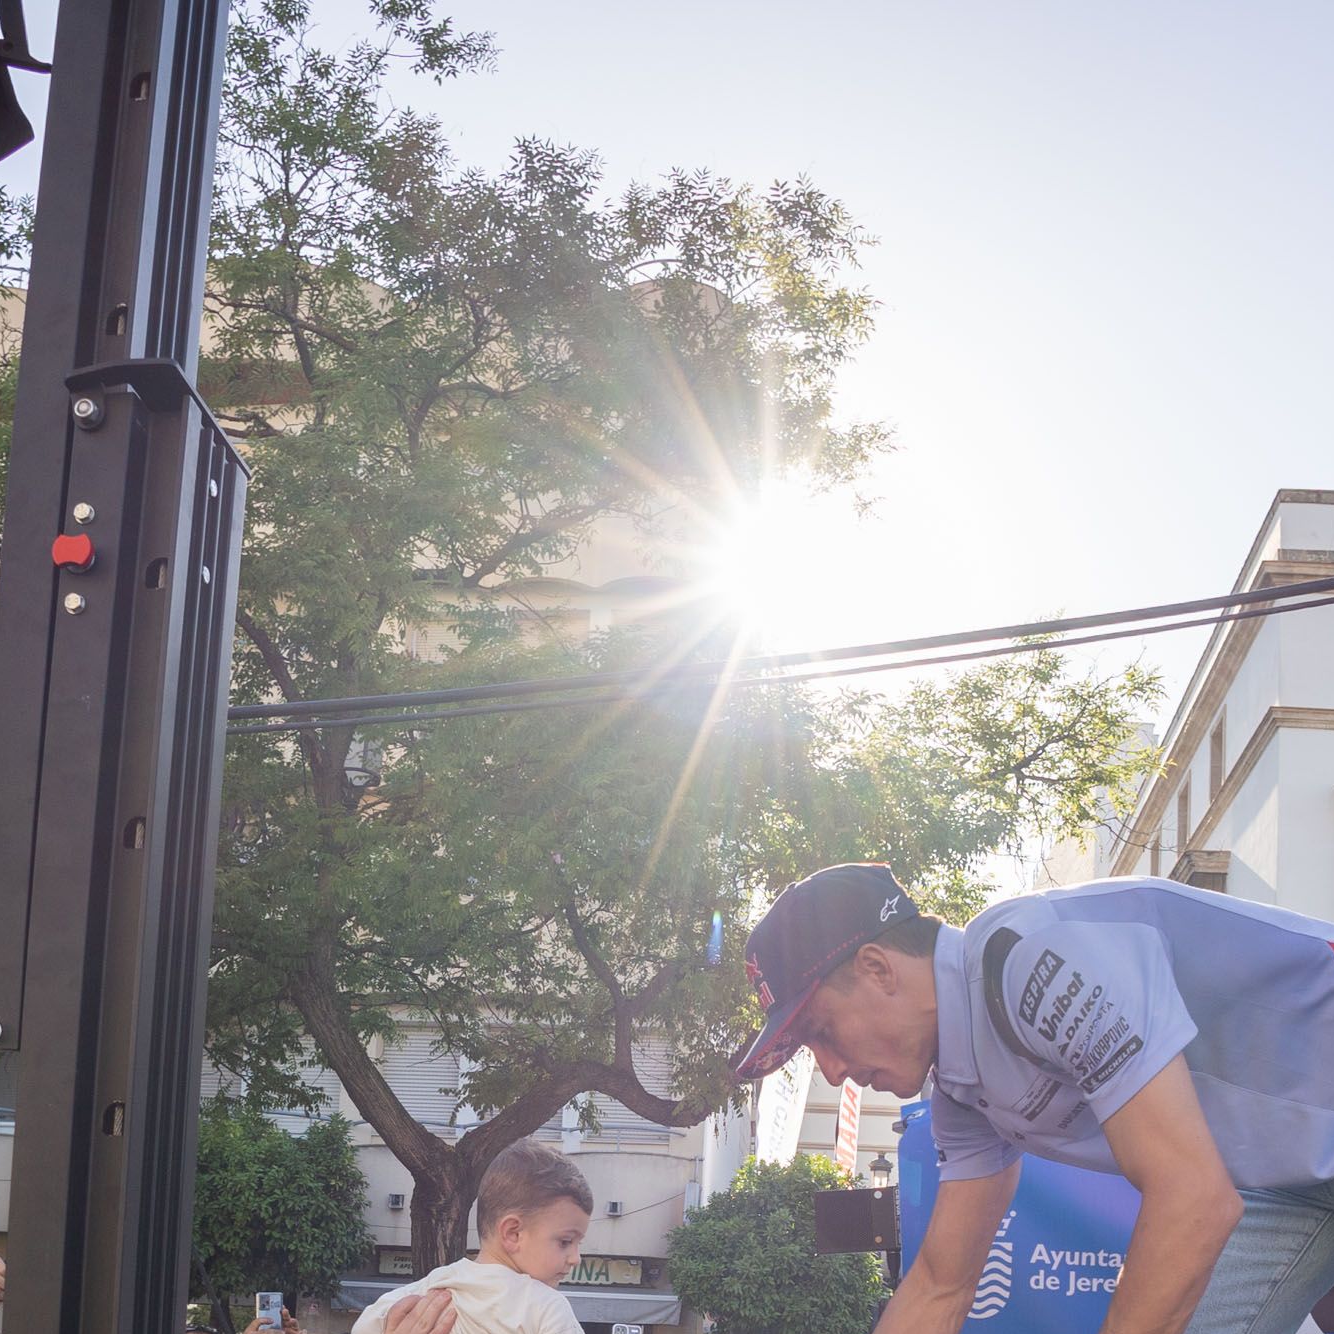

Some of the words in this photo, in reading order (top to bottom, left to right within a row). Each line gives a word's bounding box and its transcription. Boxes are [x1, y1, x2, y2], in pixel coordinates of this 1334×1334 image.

[1024, 953, 1058, 1020] ASPIRA
[1038, 970, 1086, 1042] Unibat
[1064, 985, 1103, 1042] DAIKO
[1097, 1041, 1139, 1081] MICHELIN
[836, 1084, 858, 1168] MAHA
[1029, 1243, 1125, 1271] Ayunta
[1029, 1269, 1061, 1290] de
[1066, 1270, 1118, 1297] Jere
